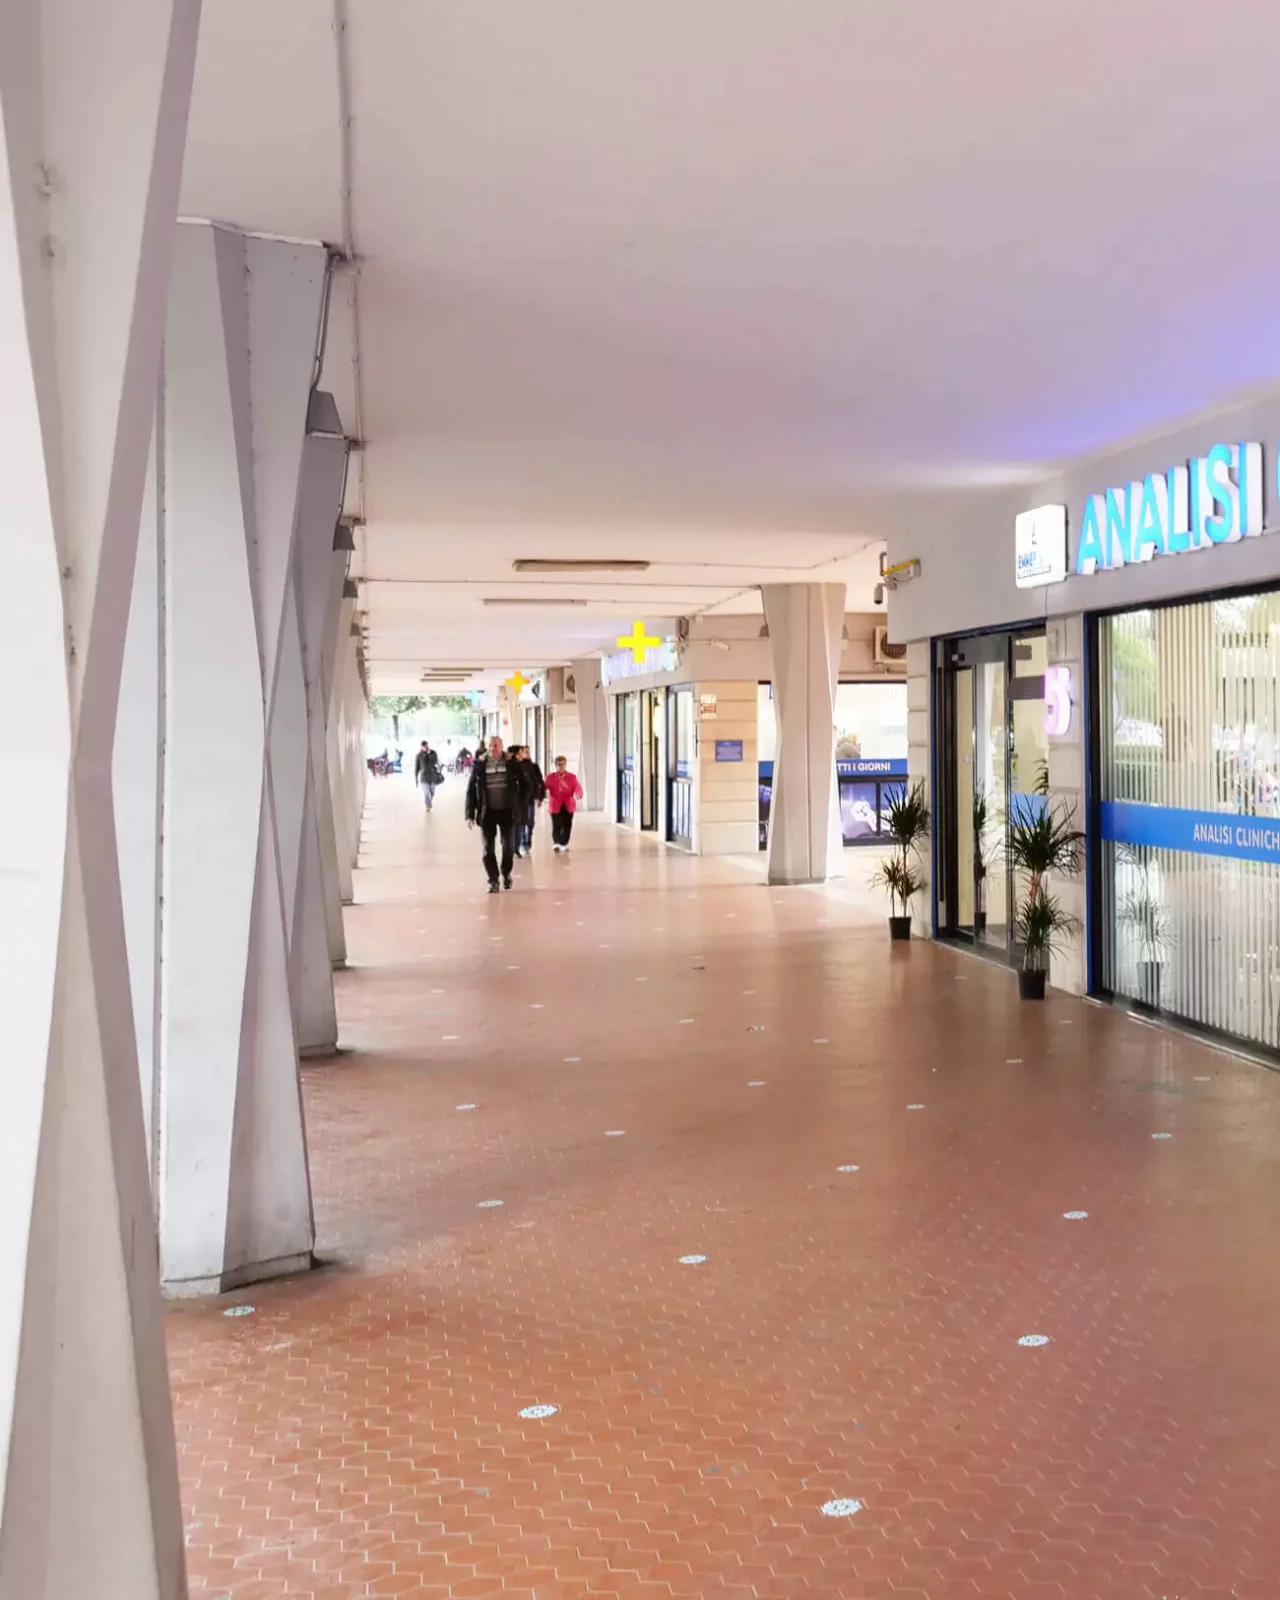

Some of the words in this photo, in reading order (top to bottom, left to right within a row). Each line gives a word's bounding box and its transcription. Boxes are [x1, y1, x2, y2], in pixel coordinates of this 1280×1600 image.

[1077, 441, 1264, 575] ANALISI
[857, 762, 891, 772] GIORNI
[1193, 822, 1232, 845] ANALISI
